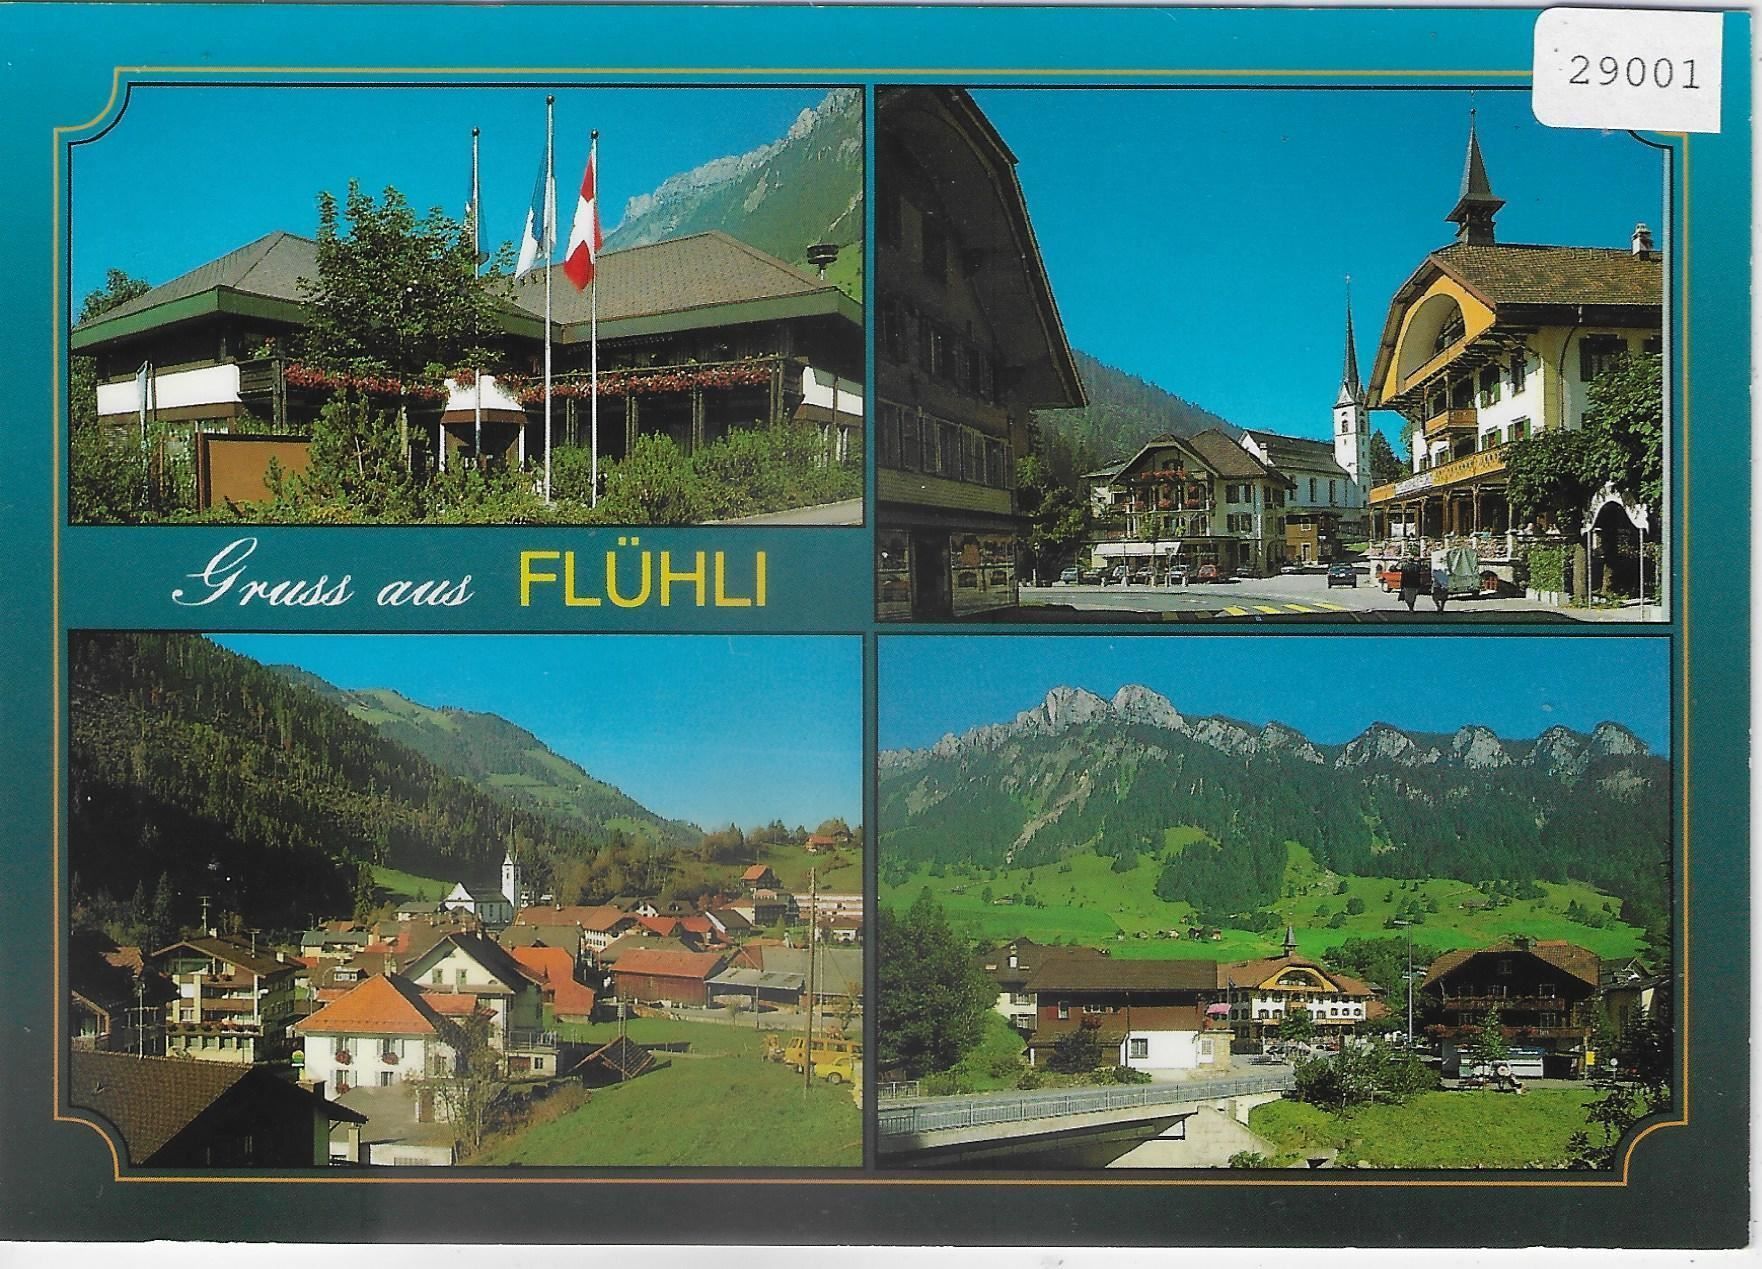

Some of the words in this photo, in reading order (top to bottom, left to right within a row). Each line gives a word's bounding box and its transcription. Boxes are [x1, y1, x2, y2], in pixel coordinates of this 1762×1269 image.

[1569, 55, 1700, 89] 29001
[171, 537, 354, 607] Gruss
[376, 574, 474, 606] aus
[520, 536, 766, 608] FLÜHLI
